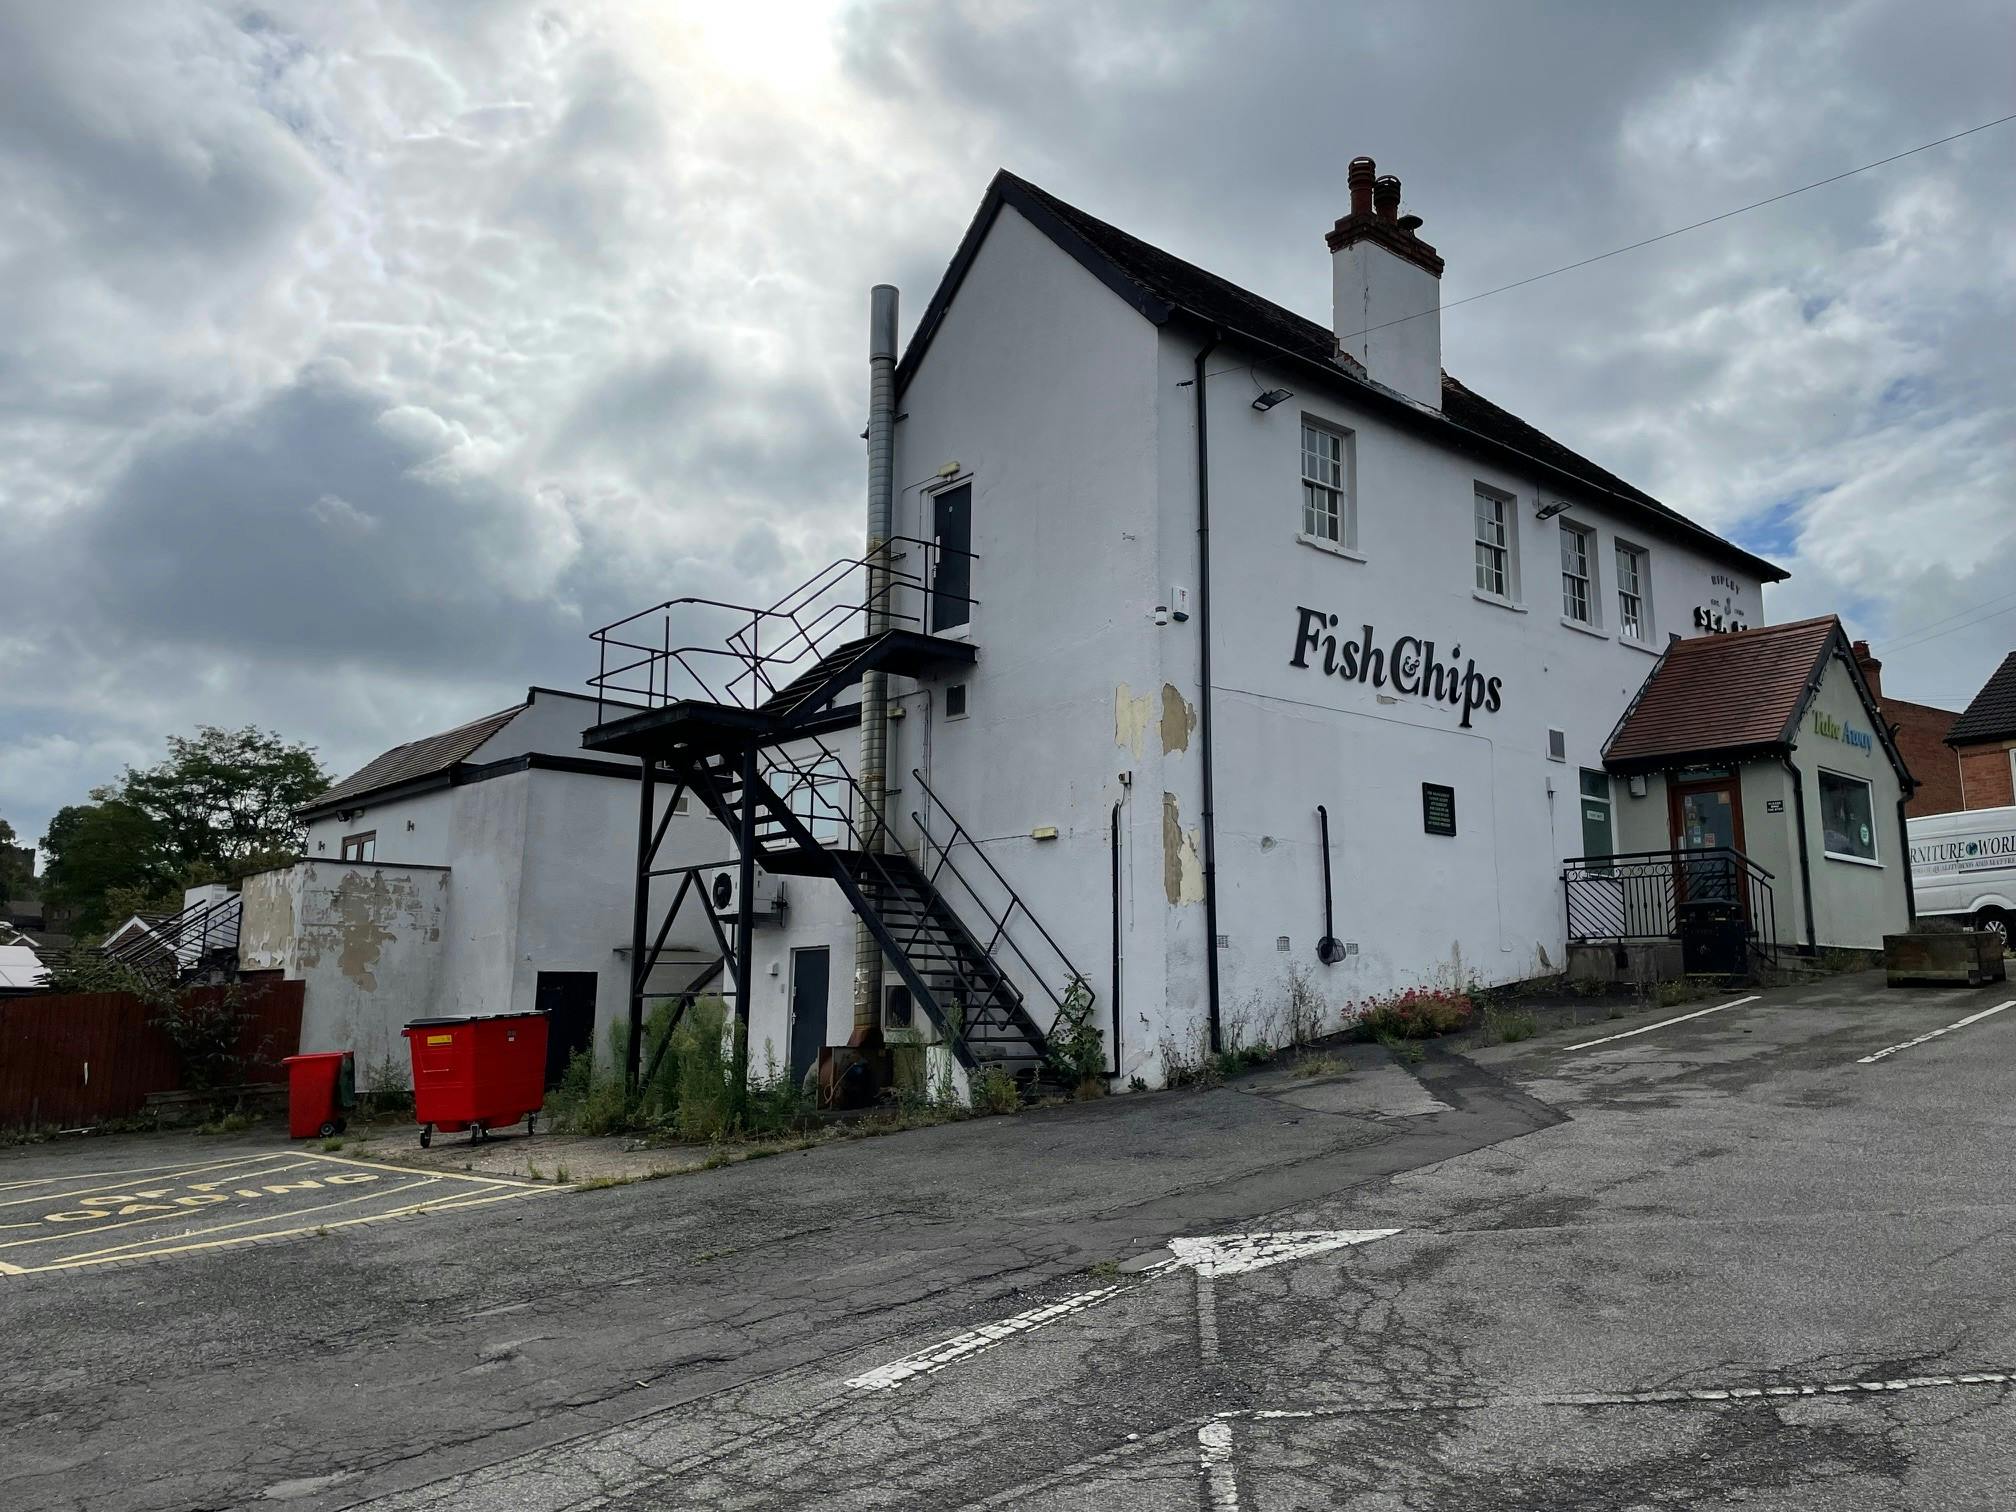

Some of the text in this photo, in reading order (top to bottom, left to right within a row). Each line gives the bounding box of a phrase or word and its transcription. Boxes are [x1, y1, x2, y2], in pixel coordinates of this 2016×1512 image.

[1289, 605, 1387, 688] Fish
[1391, 635, 1503, 728] Chips
[1812, 710, 1872, 757] Take Away
[1910, 835, 2016, 862] RNITURE WORL
[0, 1173, 380, 1229] OADING
[80, 1181, 226, 1206] OFF
